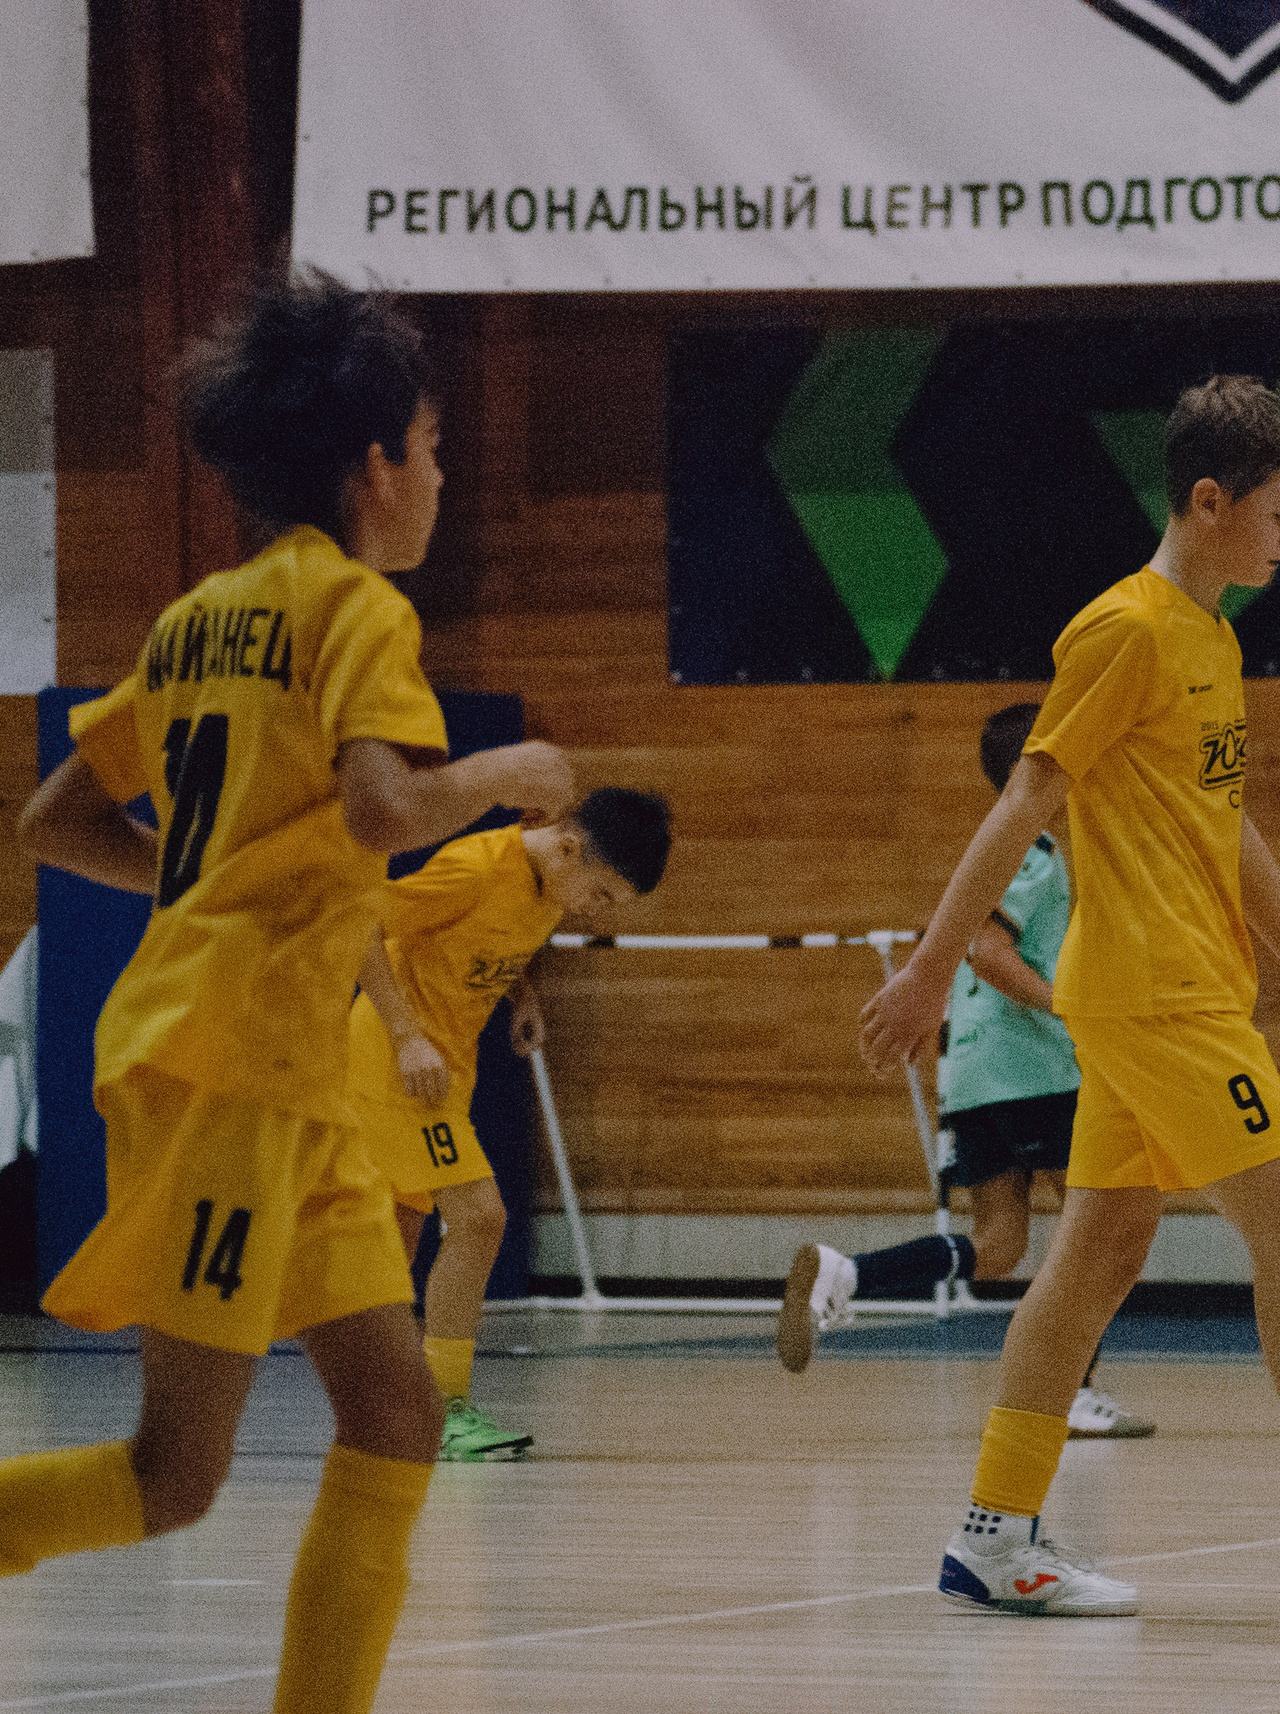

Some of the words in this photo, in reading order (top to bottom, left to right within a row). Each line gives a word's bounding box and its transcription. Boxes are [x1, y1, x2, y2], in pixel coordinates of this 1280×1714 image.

[367, 175, 818, 234] РЕГИОНАЛЬНЫЙ
[841, 182, 1027, 235] ЦЕНТР
[1228, 1074, 1270, 1134] 9
[422, 1122, 458, 1167] 19
[182, 1199, 252, 1301] 14
